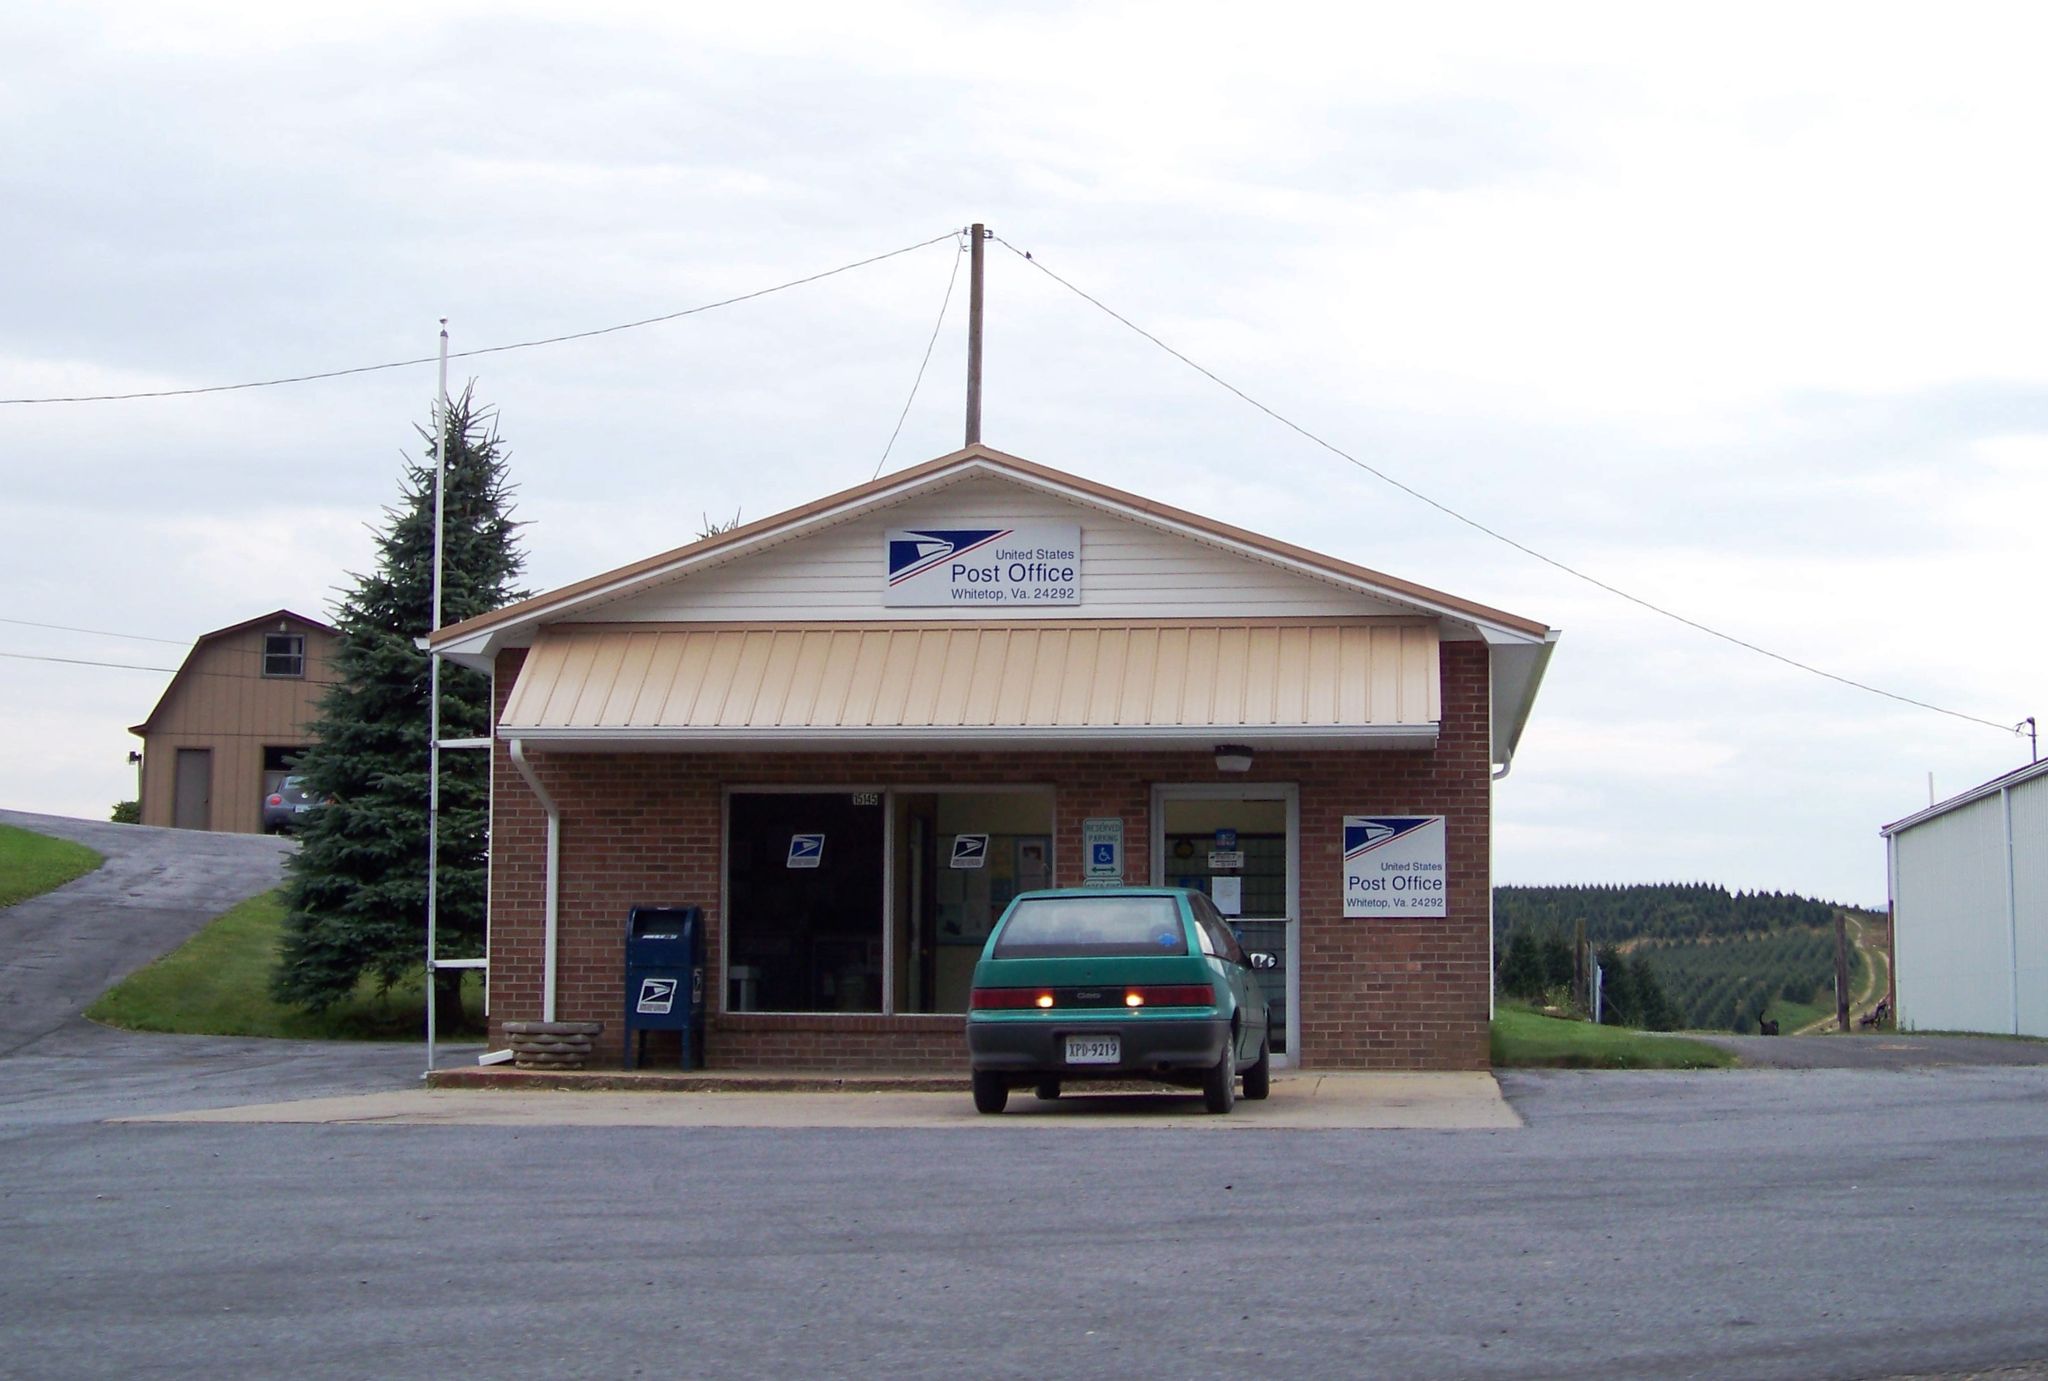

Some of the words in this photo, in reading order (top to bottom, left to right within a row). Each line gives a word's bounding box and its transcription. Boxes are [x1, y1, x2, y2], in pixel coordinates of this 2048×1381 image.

[995, 549, 1033, 560] United
[1035, 549, 1075, 560] States
[951, 564, 1000, 583] Post
[1008, 563, 1074, 583] Office
[951, 588, 1007, 602] Whitetop,
[1011, 588, 1031, 600] Va.
[1034, 588, 1074, 600] 24292
[1086, 824, 1121, 833] RESERVED
[1088, 834, 1119, 842] PARKING
[1381, 862, 1410, 871] United
[1412, 862, 1443, 871] States
[1349, 876, 1386, 891] Post
[1392, 875, 1443, 891] Office
[1346, 898, 1391, 909] Whitetop,
[1411, 898, 1443, 907] 24292
[1069, 1043, 1118, 1057] XPD-9219
